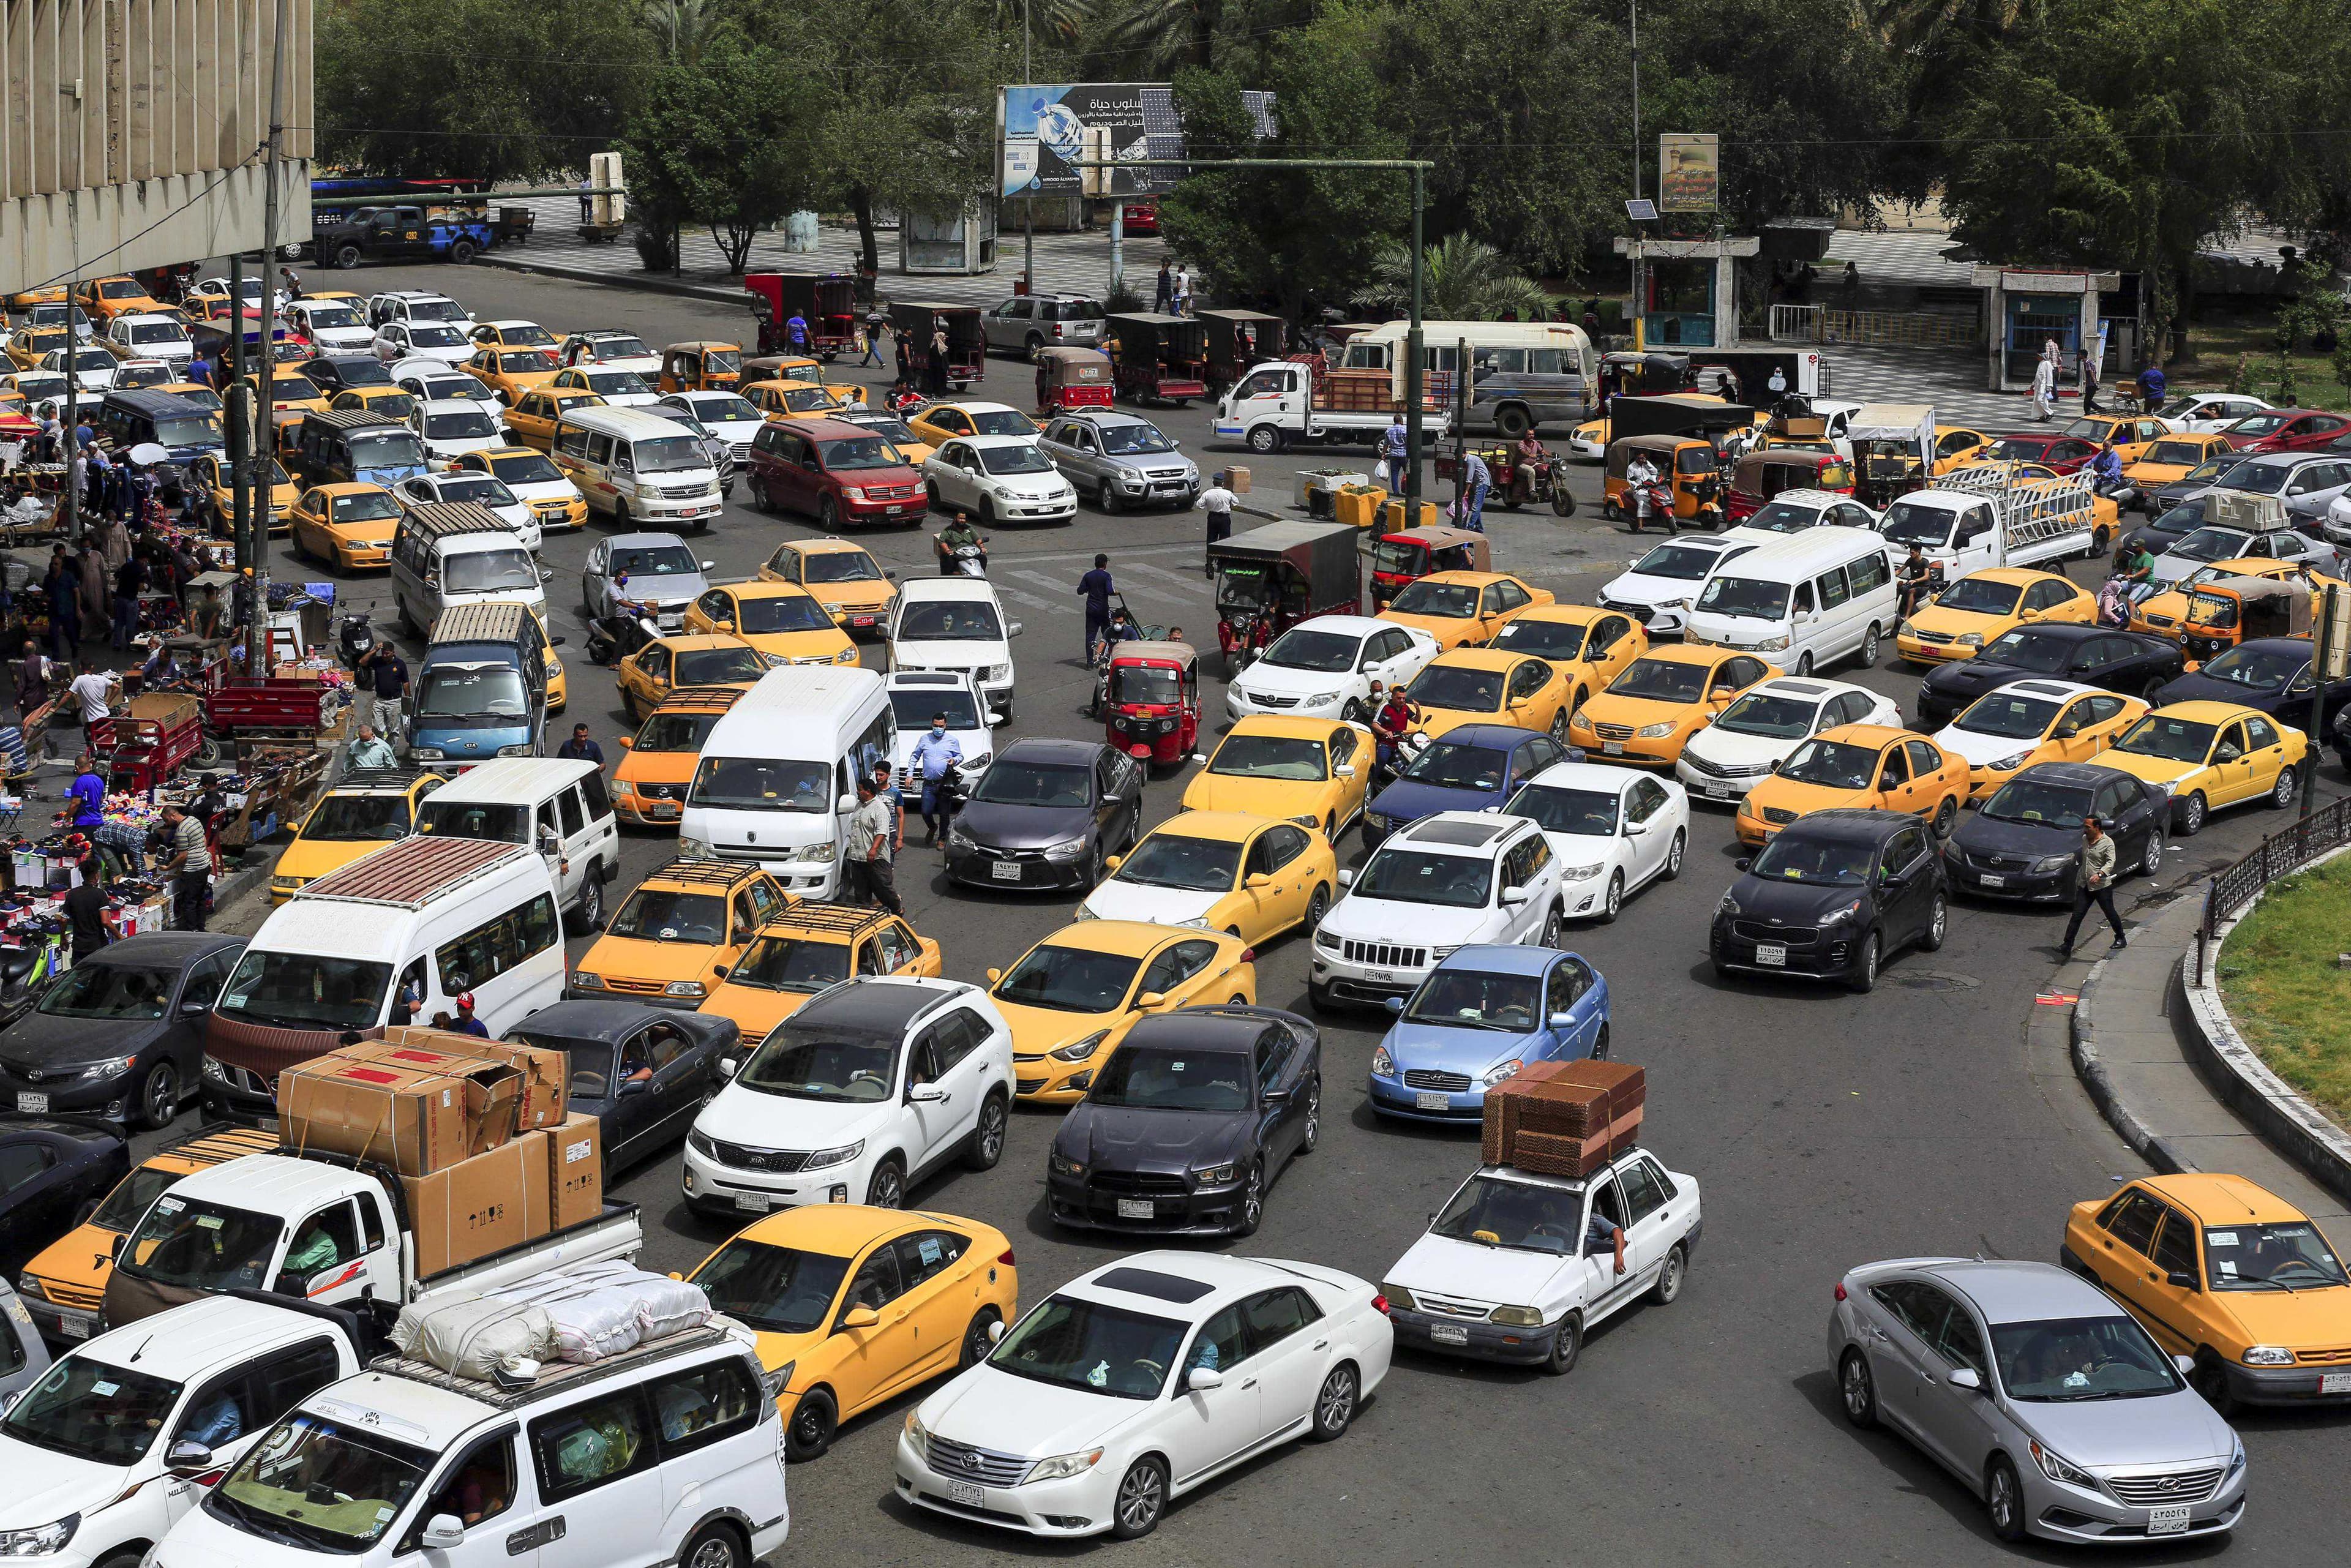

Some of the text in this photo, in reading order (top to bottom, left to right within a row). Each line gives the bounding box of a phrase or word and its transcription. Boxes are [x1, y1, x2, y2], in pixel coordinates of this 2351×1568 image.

[1090, 99, 1142, 111] سلوب حياة
[168, 1484, 192, 1498] HILUX
[2154, 1509, 2186, 1518] ٤٣٥٥٢٩
[2150, 1520, 2188, 1531] العراق اربيل
